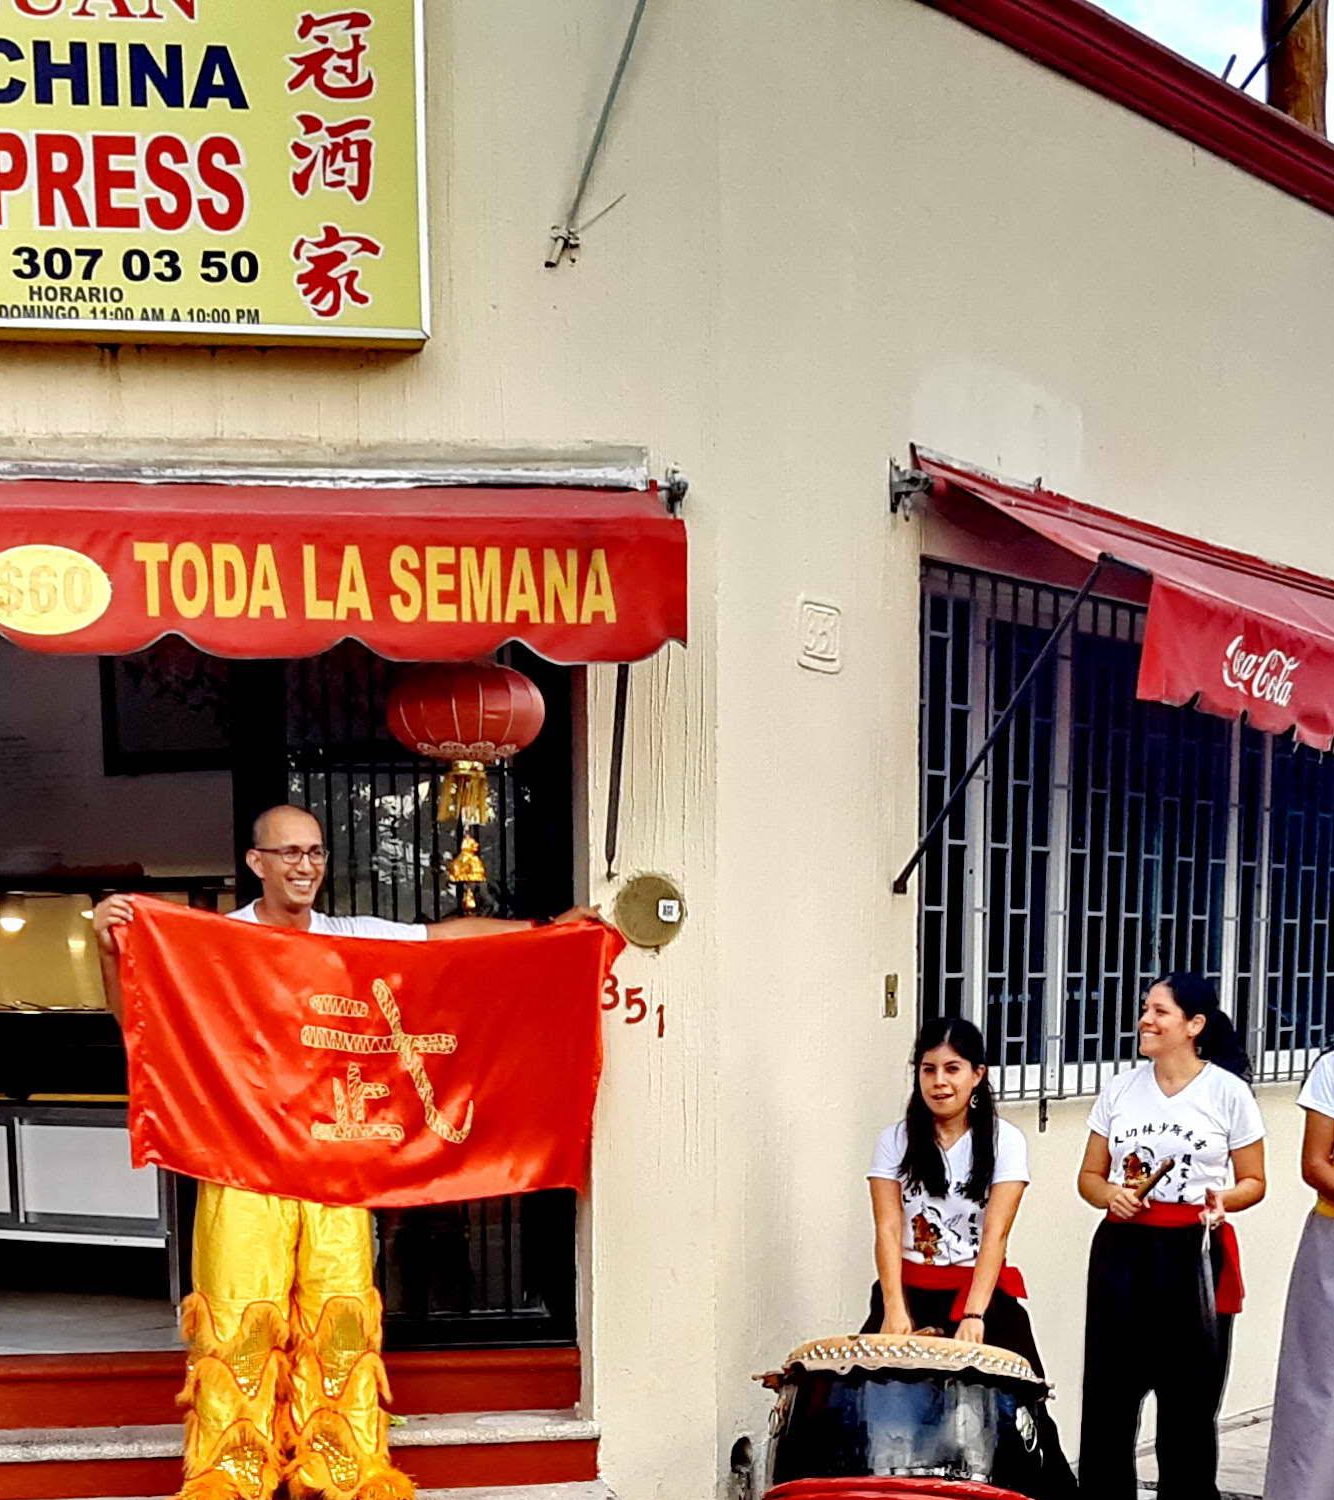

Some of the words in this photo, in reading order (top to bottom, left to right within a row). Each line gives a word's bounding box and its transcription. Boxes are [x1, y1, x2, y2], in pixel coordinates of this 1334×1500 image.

[12, 246, 103, 281] 307
[122, 249, 182, 283] 03
[200, 250, 259, 284] 50
[29, 285, 124, 303] HORARIO
[140, 308, 164, 322] AM
[171, 308, 181, 322] A
[187, 308, 230, 324] 10:00
[236, 309, 260, 325] PM
[133, 541, 287, 621] TODA
[303, 545, 373, 623] LA
[389, 546, 618, 625] SEMANA
[601, 973, 665, 1038] 351
